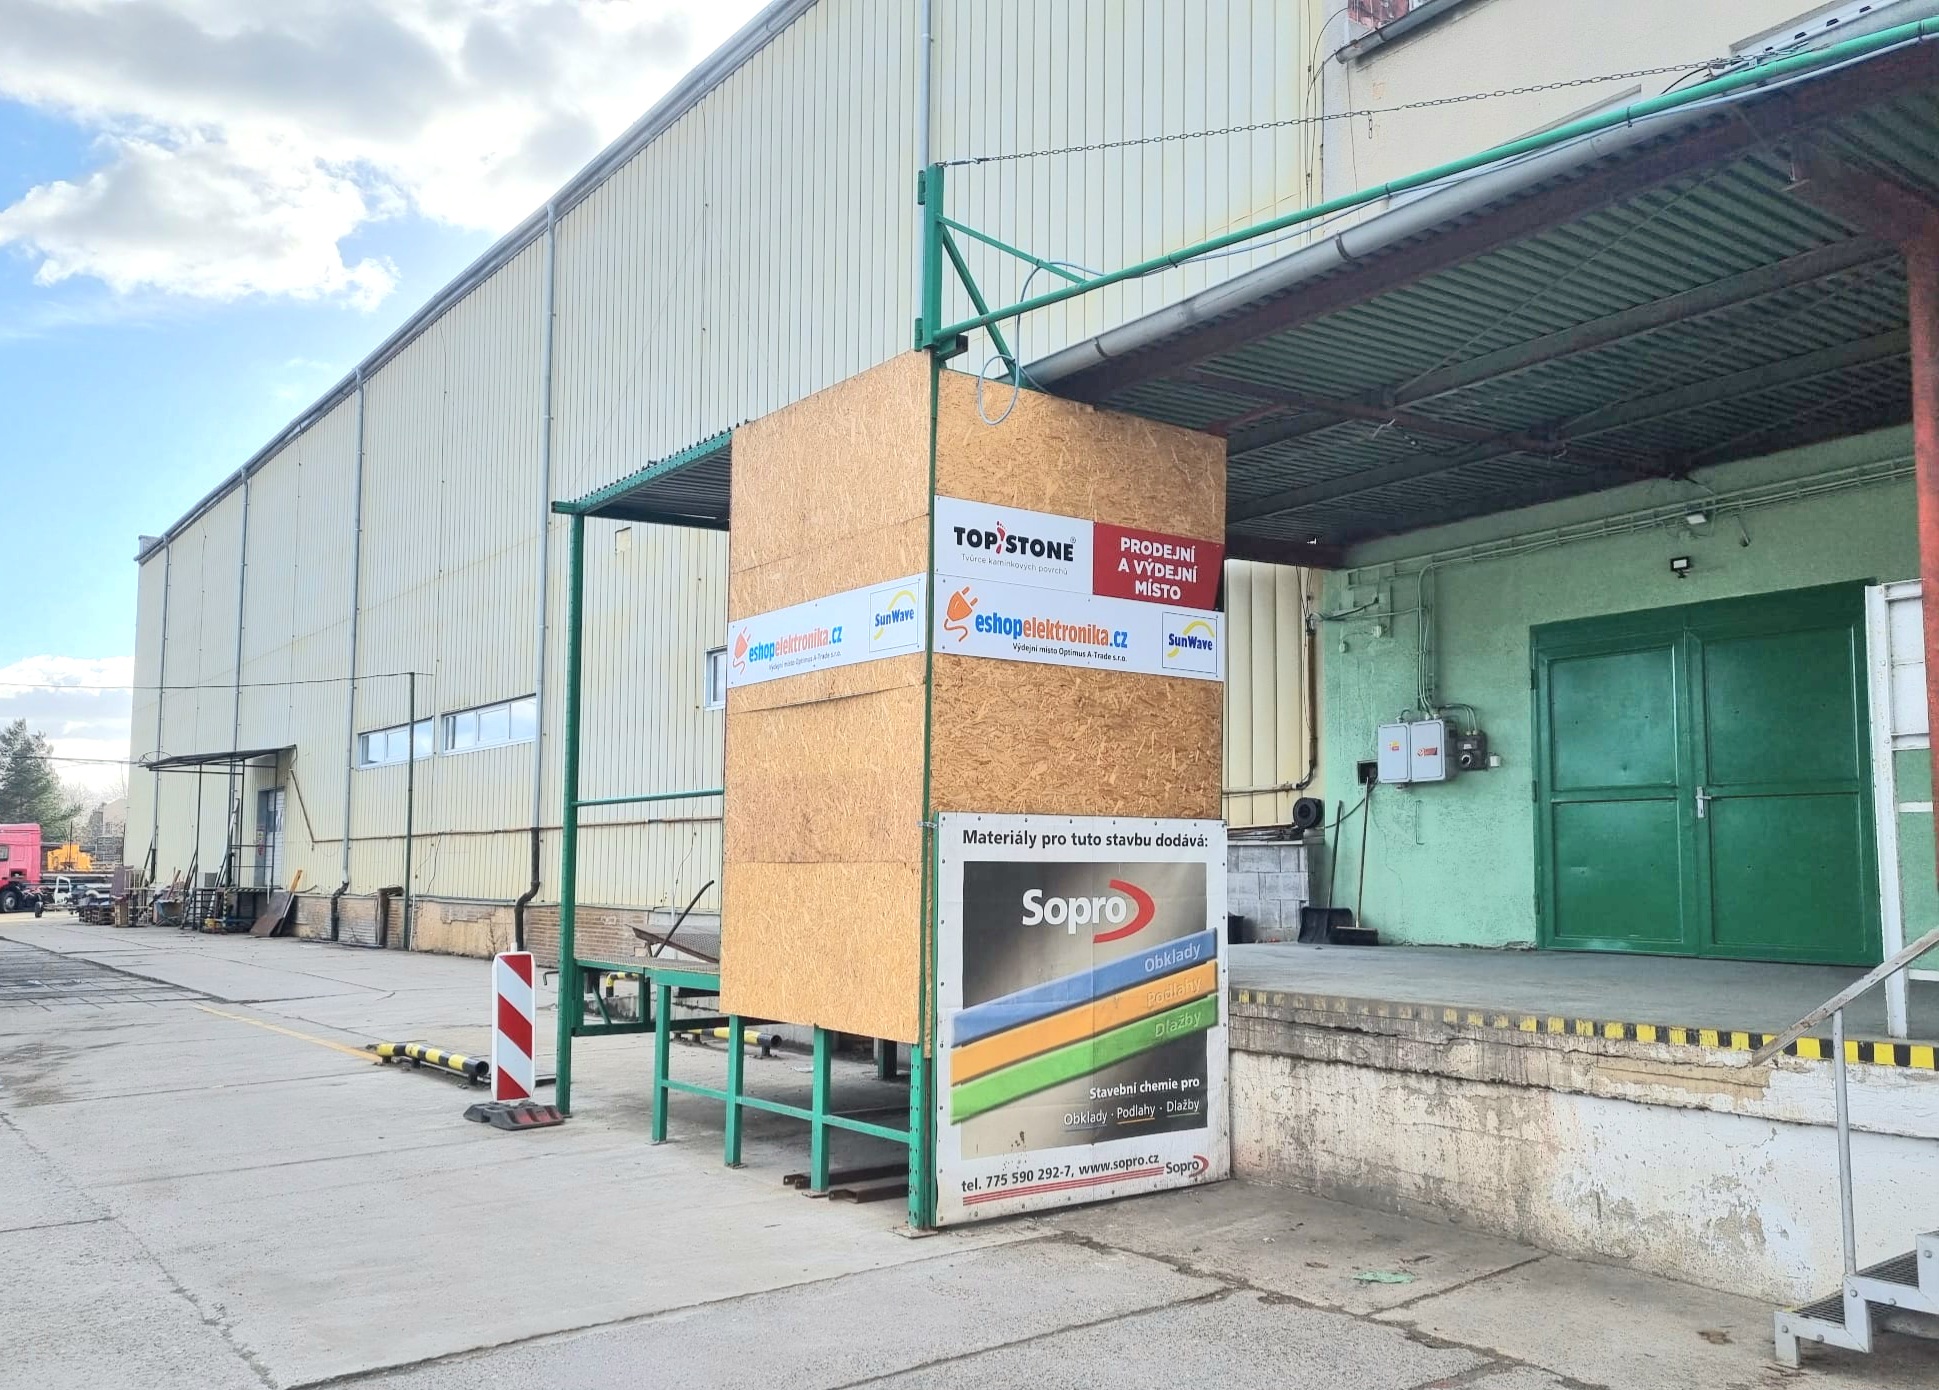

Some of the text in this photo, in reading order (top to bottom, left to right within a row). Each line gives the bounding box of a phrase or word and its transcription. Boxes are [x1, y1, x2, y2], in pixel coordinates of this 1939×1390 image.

[962, 553, 987, 564] Tvůrce
[1120, 536, 1196, 563] PRODEJNÍ
[1117, 559, 1198, 584] A VÝDEJNÍ
[1134, 575, 1182, 600] MÍSTO
[874, 607, 915, 627] SunWave
[975, 611, 1128, 649] eshopelektronika.cz
[1168, 632, 1213, 652] SunWave
[749, 625, 843, 663] eshopelektronika.cz
[1058, 648, 1086, 658] Optimus
[1087, 651, 1112, 661] A-Trade
[1112, 655, 1127, 663] s.r.o.
[962, 829, 1208, 849] Materiály pro tuto stavbu dodává:
[1022, 888, 1128, 935] Sopro
[1145, 943, 1201, 972] Obklady
[1147, 978, 1201, 1008] Podlahy
[1155, 1012, 1201, 1038] Dlažby
[1089, 1077, 1200, 1100] Stavební chemie pro
[1064, 1099, 1200, 1127] Obklady Podlahy Dlažby
[961, 1153, 1160, 1192] tel. 775 590 292-7, www.sopro.cz
[1165, 1158, 1200, 1178] Sopro
